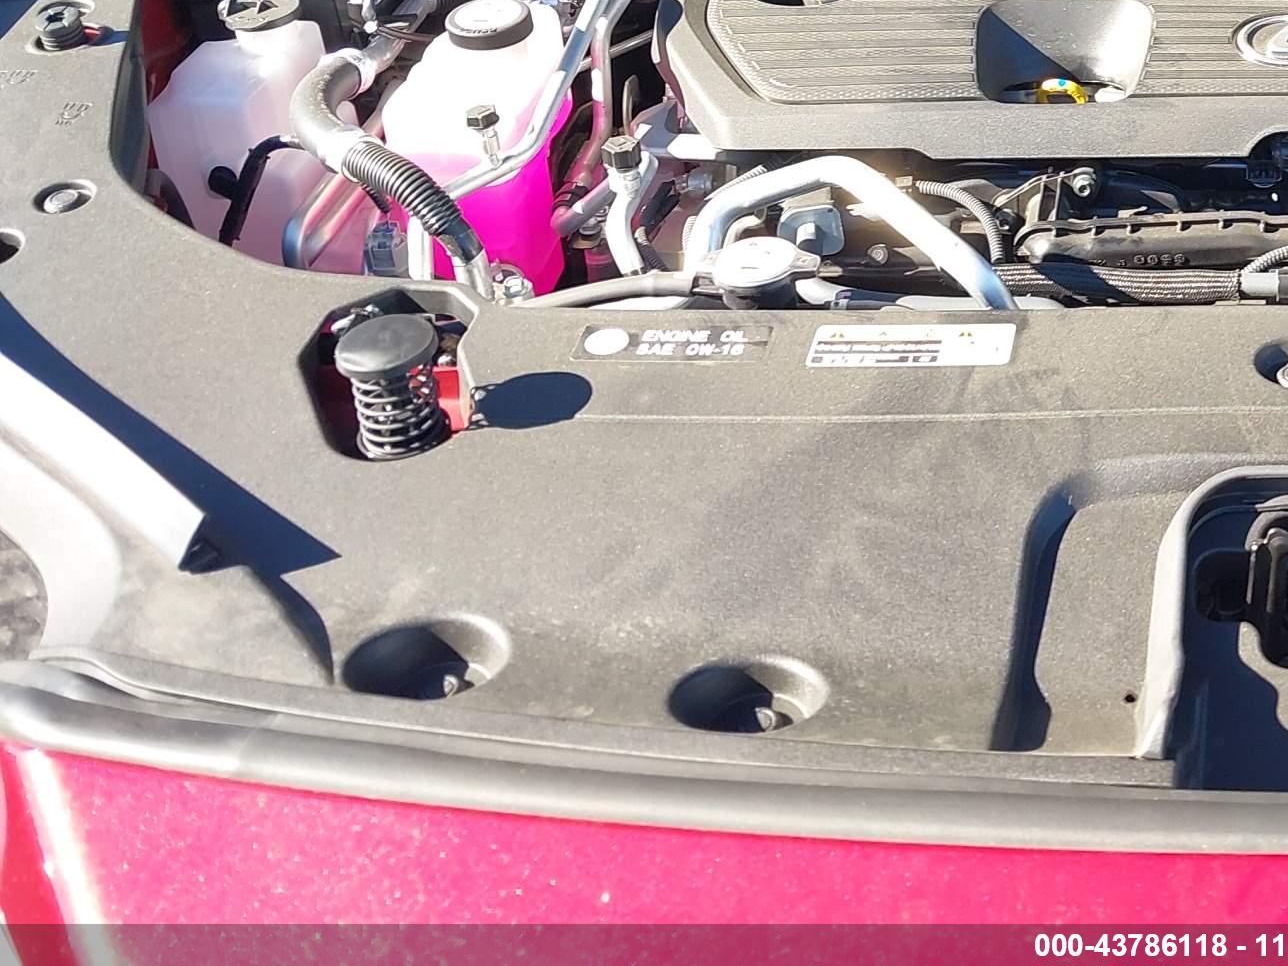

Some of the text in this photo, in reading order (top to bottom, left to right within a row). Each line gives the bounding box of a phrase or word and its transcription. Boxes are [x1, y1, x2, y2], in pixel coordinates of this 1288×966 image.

[641, 329, 749, 342] ENGINE OIL
[636, 343, 676, 356] SAE
